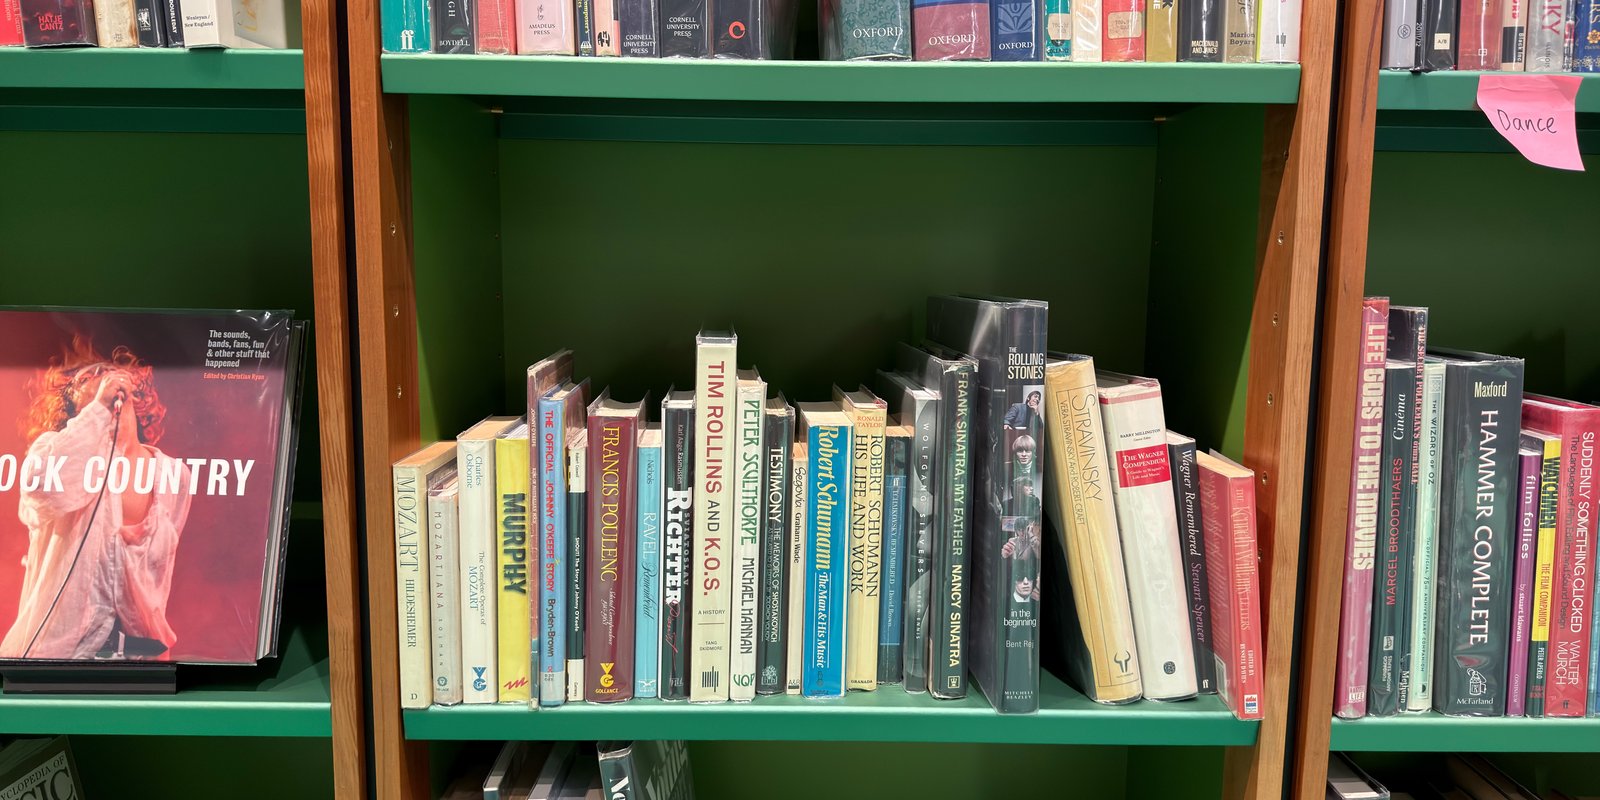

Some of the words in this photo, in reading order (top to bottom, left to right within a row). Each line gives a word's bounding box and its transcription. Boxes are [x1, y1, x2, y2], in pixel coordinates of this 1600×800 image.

[38, 15, 63, 23] HATJE
[40, 22, 64, 31] CANTZ
[674, 30, 692, 38] PRESS
[854, 27, 903, 40] OXFORD
[400, 29, 414, 50] ff
[624, 40, 656, 48] UNIVERSITY
[928, 34, 976, 46] OXFORD
[999, 41, 1033, 50] OXFORD
[1497, 108, 1558, 134] Dance
[206, 349, 214, 358] &
[214, 349, 234, 358] other
[236, 350, 254, 358] stuff
[254, 350, 270, 358] that
[208, 340, 232, 349] bands,
[233, 340, 251, 349] fans,
[252, 340, 265, 348] fun
[209, 330, 222, 338] The
[223, 331, 251, 340] sounds,
[1368, 324, 1386, 362] LIFE
[204, 372, 220, 380] Edited
[227, 372, 250, 380] Christian
[206, 358, 240, 368] happened
[1008, 353, 1044, 366] ROLLING
[1008, 366, 1044, 380] STONES
[708, 361, 724, 398] TIM
[958, 371, 969, 416] FRANK
[1361, 368, 1385, 420] GOES
[1474, 380, 1508, 398] Maxford
[544, 410, 554, 428] THE
[742, 400, 760, 447] PETER
[1392, 392, 1406, 440] Cinéma
[545, 433, 555, 474] OFFICIAL
[706, 405, 724, 494] ROLLINS
[818, 426, 838, 480] Robert
[855, 436, 868, 460] HIS
[954, 422, 967, 481] SINATRA,
[1071, 393, 1103, 501] STRAVINSKY
[1138, 450, 1165, 460] WAGNER
[1360, 422, 1382, 450] TO
[0, 454, 68, 493] OCK
[83, 456, 255, 496] COUNTRY
[466, 453, 475, 489] Osborne
[476, 456, 484, 486] Charles
[602, 426, 620, 497] FRANCIS
[646, 460, 654, 485] Nichols
[869, 434, 884, 496] ROBERT
[920, 422, 930, 502] WOLFGANG
[1122, 458, 1166, 469] COMPENDIUM
[1180, 450, 1193, 489] Wagner
[1357, 452, 1380, 490] THE
[1428, 472, 1434, 485] OZ
[1476, 410, 1498, 521] HAMMER
[1579, 432, 1594, 500] SUDDENLY
[546, 480, 555, 520] JOHNNY
[741, 452, 760, 546] SCULTHORPE
[768, 446, 784, 523] TESTIMONY
[794, 466, 806, 506] Segovia
[854, 466, 868, 498] LIFE
[954, 484, 965, 504] MY
[1524, 474, 1537, 504] film
[1540, 456, 1560, 528] WATCHMEN
[396, 476, 418, 572] MOZART
[707, 500, 720, 532] AND
[853, 502, 866, 539] AND
[1184, 492, 1202, 556] Remembered
[1388, 458, 1402, 553] BROODTHAERS
[503, 493, 527, 596] MURPHY
[546, 524, 555, 559] O'KEEFE
[600, 502, 618, 582] POULENC
[642, 512, 656, 560] RAVEL
[772, 527, 782, 543] THE
[816, 480, 838, 571] Schumann
[917, 512, 926, 574] SIEVERS
[952, 508, 964, 556] FATHER
[1353, 492, 1378, 570] MOVIES
[1521, 514, 1534, 560] follies
[1574, 502, 1590, 576] SOMETHING
[666, 487, 692, 605] RICHTER
[772, 544, 780, 578] MEMOIRS
[866, 500, 881, 598] SCHUMANN
[546, 563, 555, 592] STORY
[704, 538, 720, 596] K.O.S.
[740, 558, 755, 606] MICHAEL
[771, 580, 780, 590] OF
[818, 572, 828, 586] The
[851, 544, 864, 594] WORK
[1190, 563, 1202, 604] Stewart
[1386, 558, 1398, 606] MARCEL
[1470, 525, 1493, 646] COMPLETE
[1540, 576, 1550, 590] FILM
[1542, 564, 1550, 575] THE
[468, 566, 479, 612] MOZART
[642, 562, 658, 620] Remembered
[818, 586, 828, 614] Man
[950, 564, 962, 609] NANCY
[1518, 592, 1526, 614] stuart
[1520, 584, 1526, 592] by
[406, 579, 416, 648] HILDESHEIMER
[770, 592, 780, 643] SHOSTAKOVICH
[1004, 618, 1037, 628] beginning
[1010, 609, 1018, 618] in
[1018, 608, 1031, 618] the
[1193, 604, 1206, 643] Spencer
[1538, 592, 1549, 627] COMPANION
[1570, 580, 1585, 633] CLICKED
[546, 598, 556, 658] Bryden-Brown
[740, 609, 754, 655] HANNAN
[818, 620, 827, 638] His
[949, 612, 962, 667] SINATRA
[1006, 640, 1022, 648] Bent
[1516, 615, 1526, 642] klawans
[816, 638, 827, 668] Music
[1536, 663, 1544, 680] APERLO
[1556, 642, 1568, 686] MURCH
[1568, 640, 1580, 685] WALTER
[733, 673, 756, 686] UQP
[1400, 670, 1410, 704] Methuen
[1456, 697, 1494, 705] McFarland
